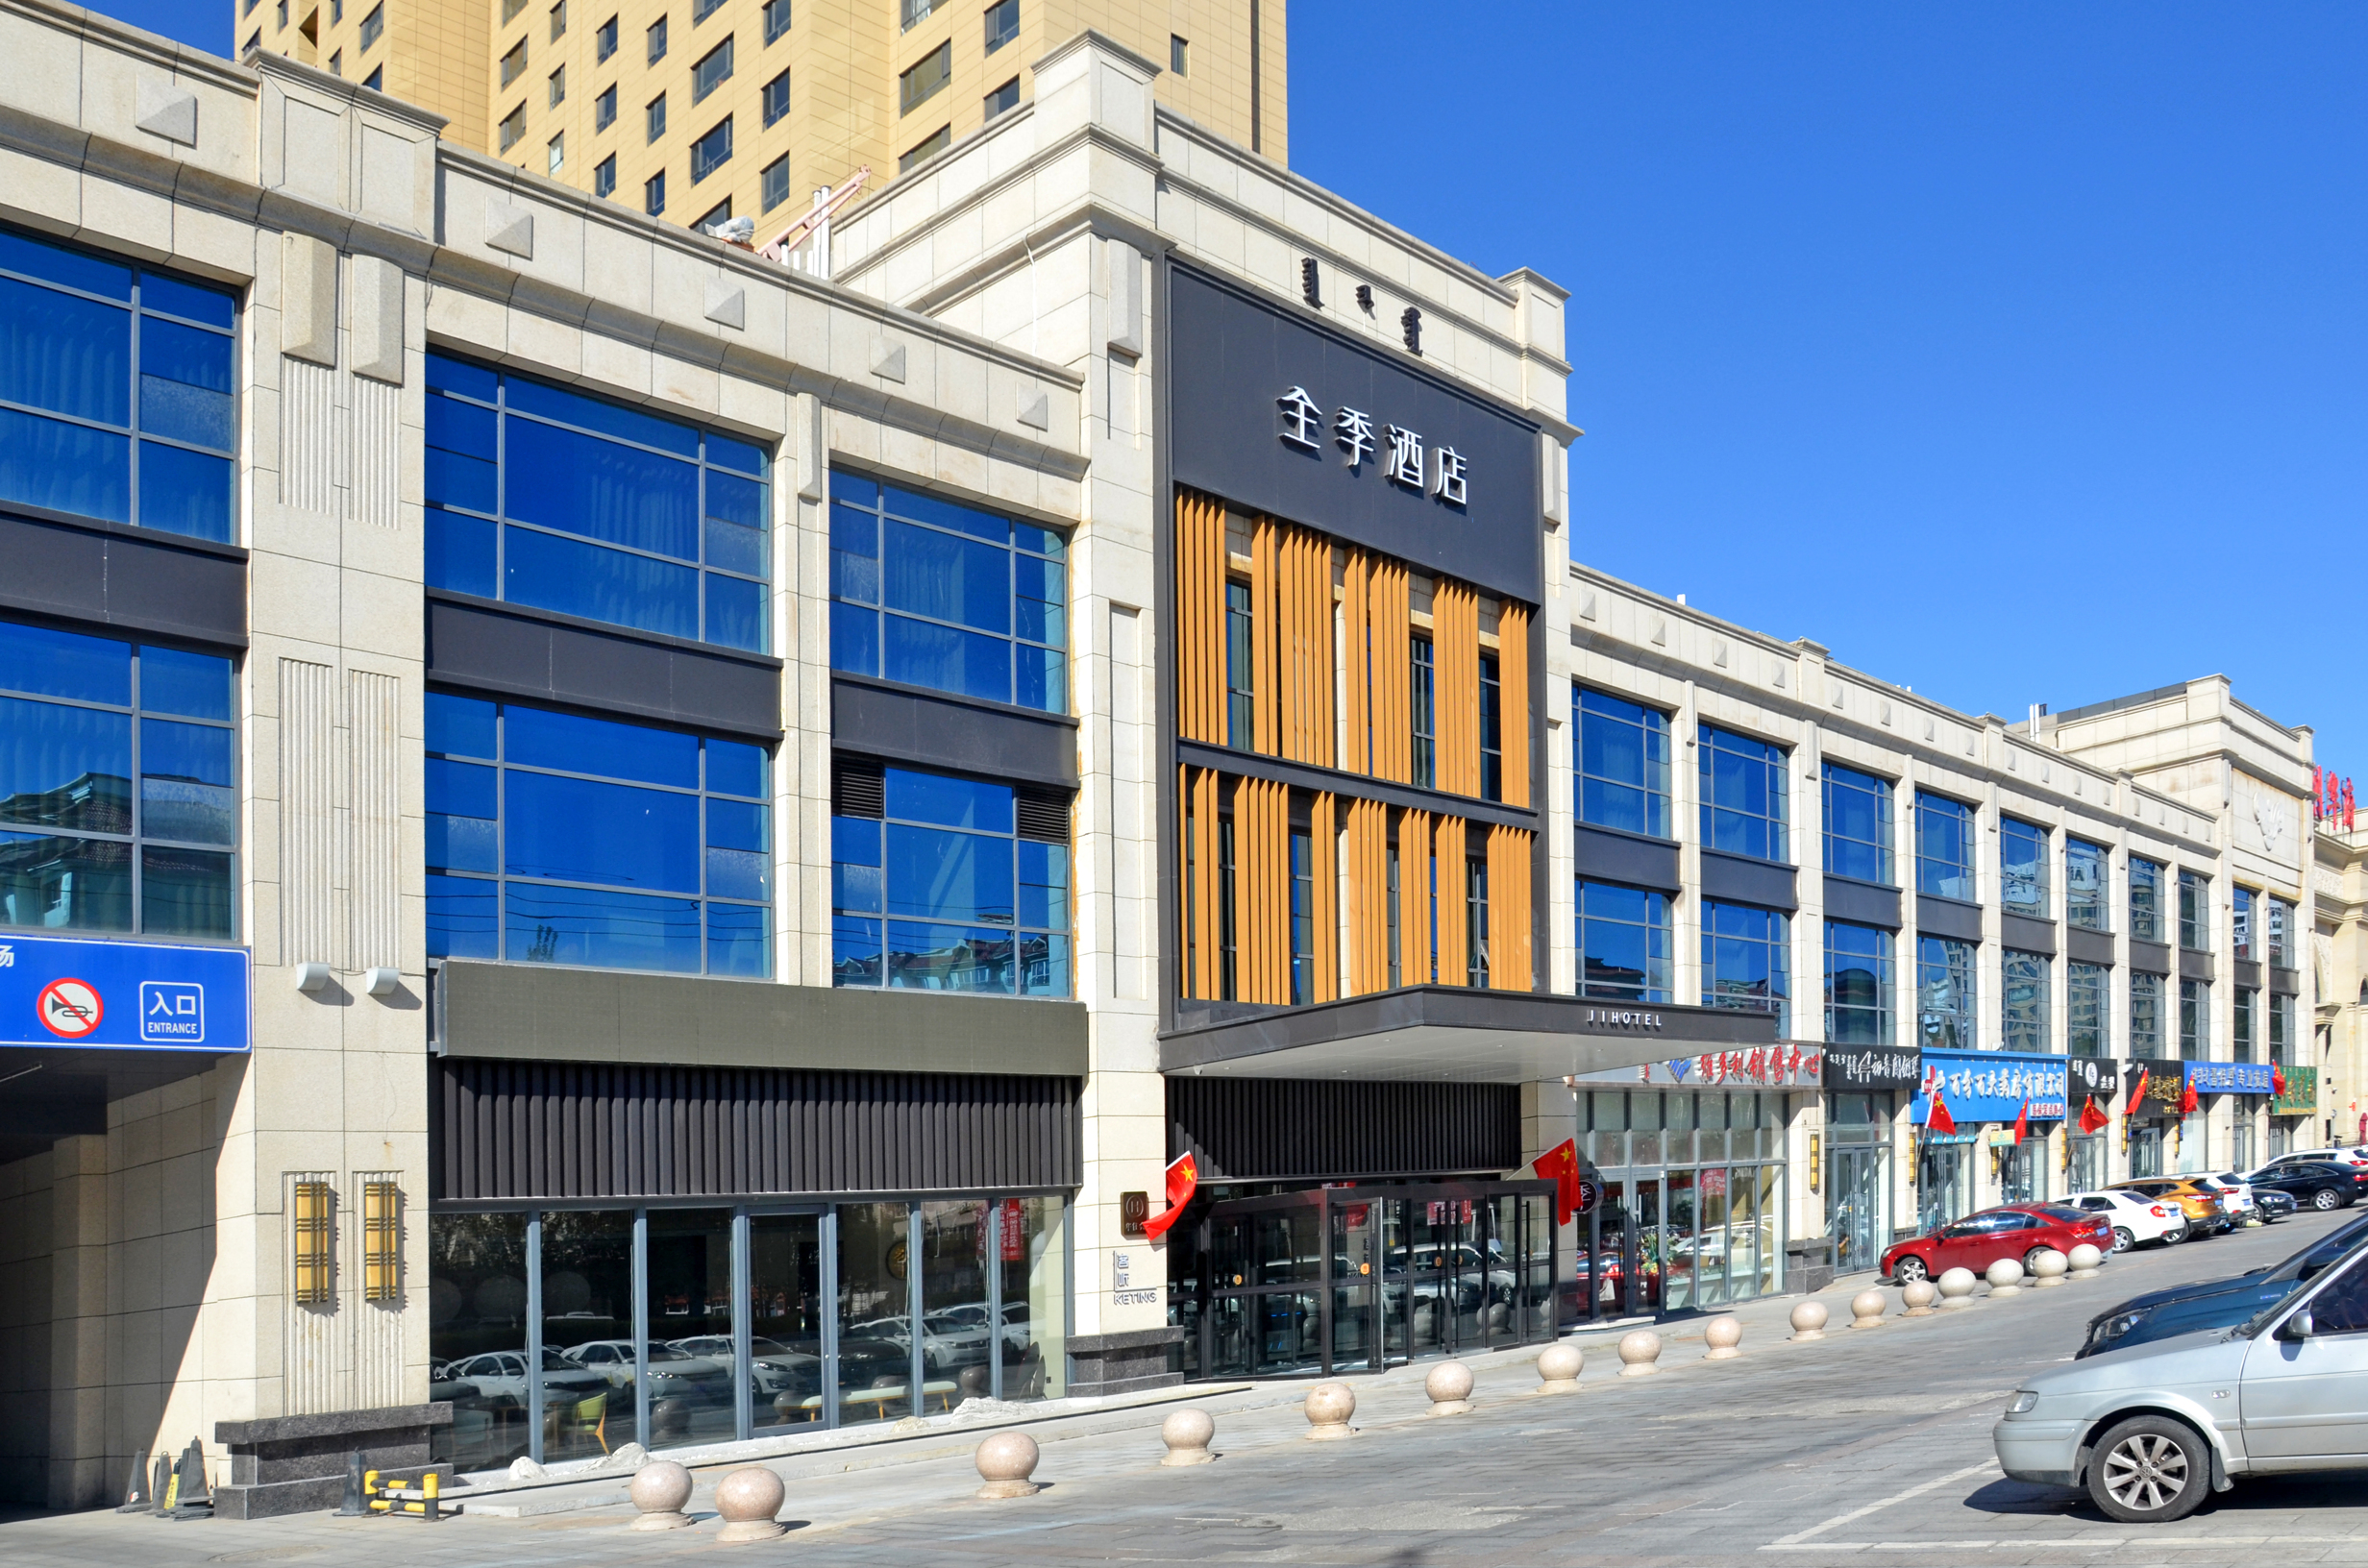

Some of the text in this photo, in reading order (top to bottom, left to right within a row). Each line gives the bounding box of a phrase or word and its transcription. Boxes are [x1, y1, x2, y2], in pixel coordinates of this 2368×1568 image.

[1278, 385, 1468, 505] 全季酒店
[148, 992, 196, 1016] 入口
[147, 1021, 198, 1035] ENTRANCE
[1695, 1043, 1820, 1086] 维多利销售中心
[1113, 1291, 1158, 1307] KETING
